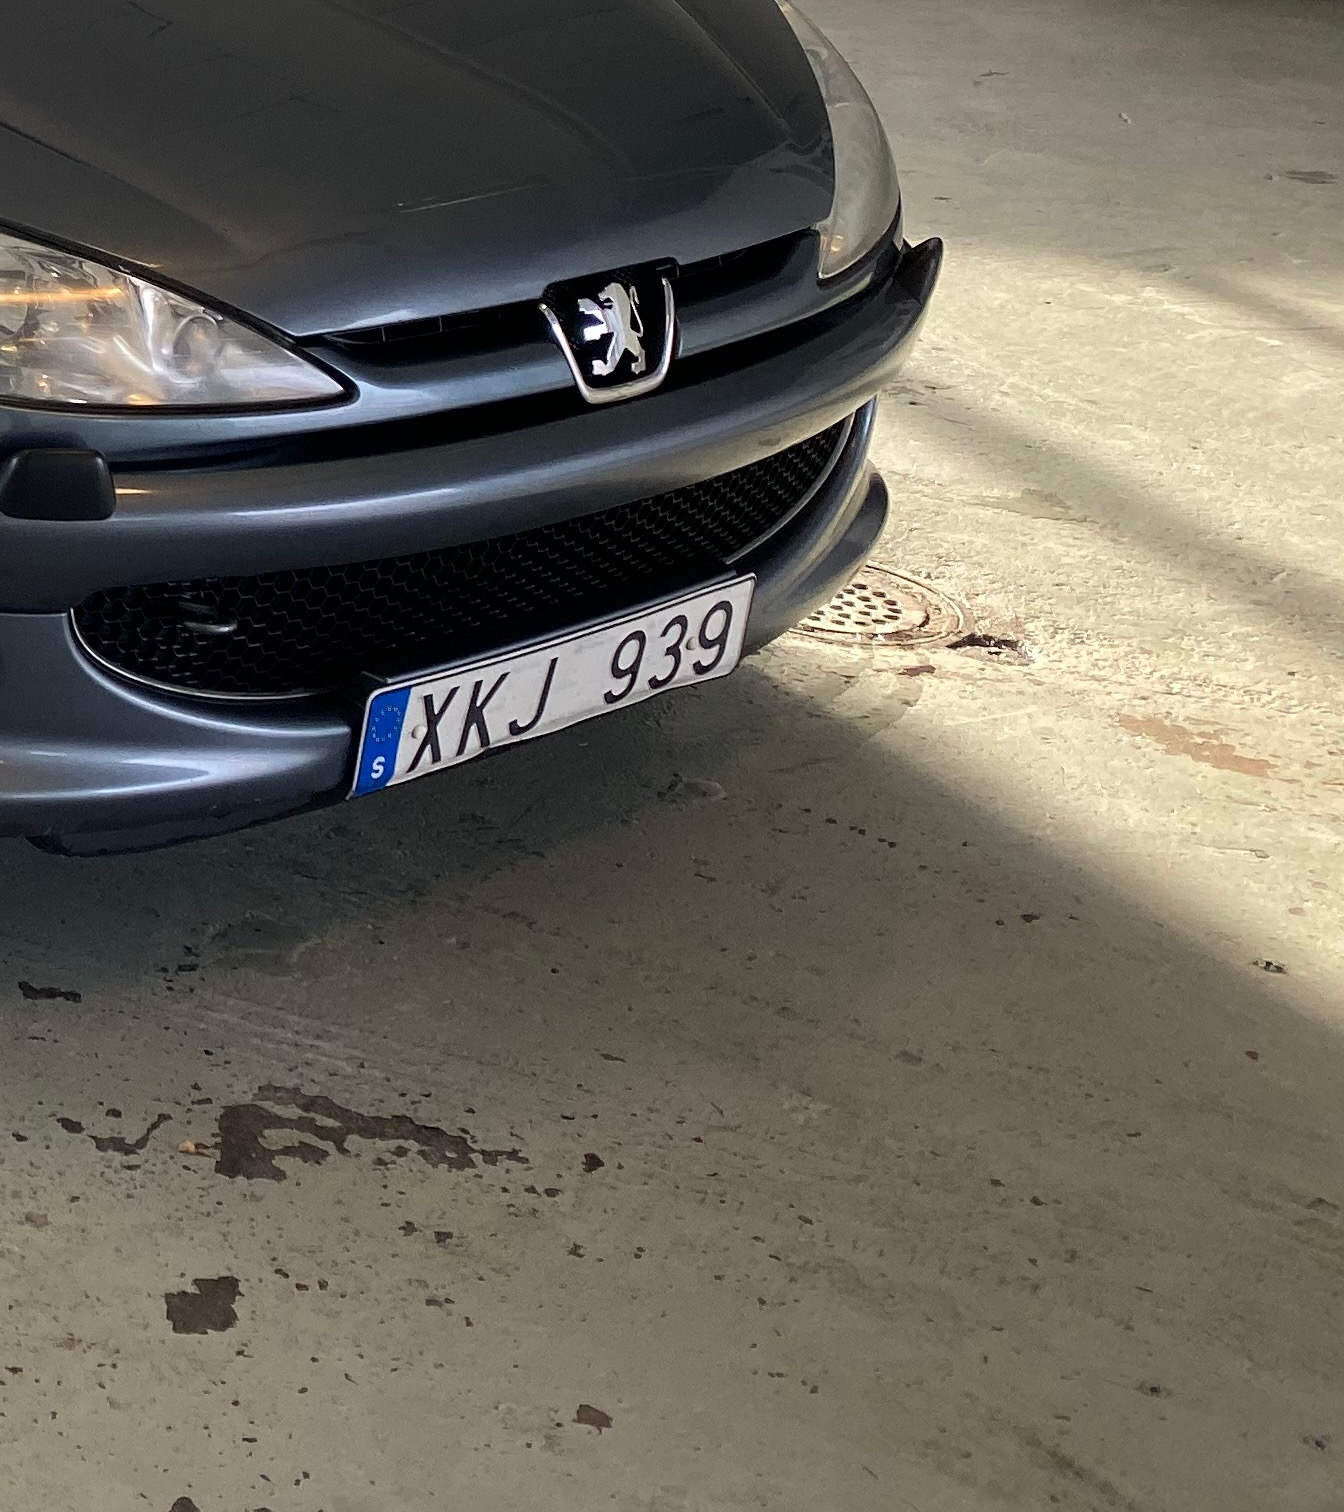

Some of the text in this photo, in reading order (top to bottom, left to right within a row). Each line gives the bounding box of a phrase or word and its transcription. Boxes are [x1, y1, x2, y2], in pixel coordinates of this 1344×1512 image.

[370, 600, 734, 780] S XKJ 939
